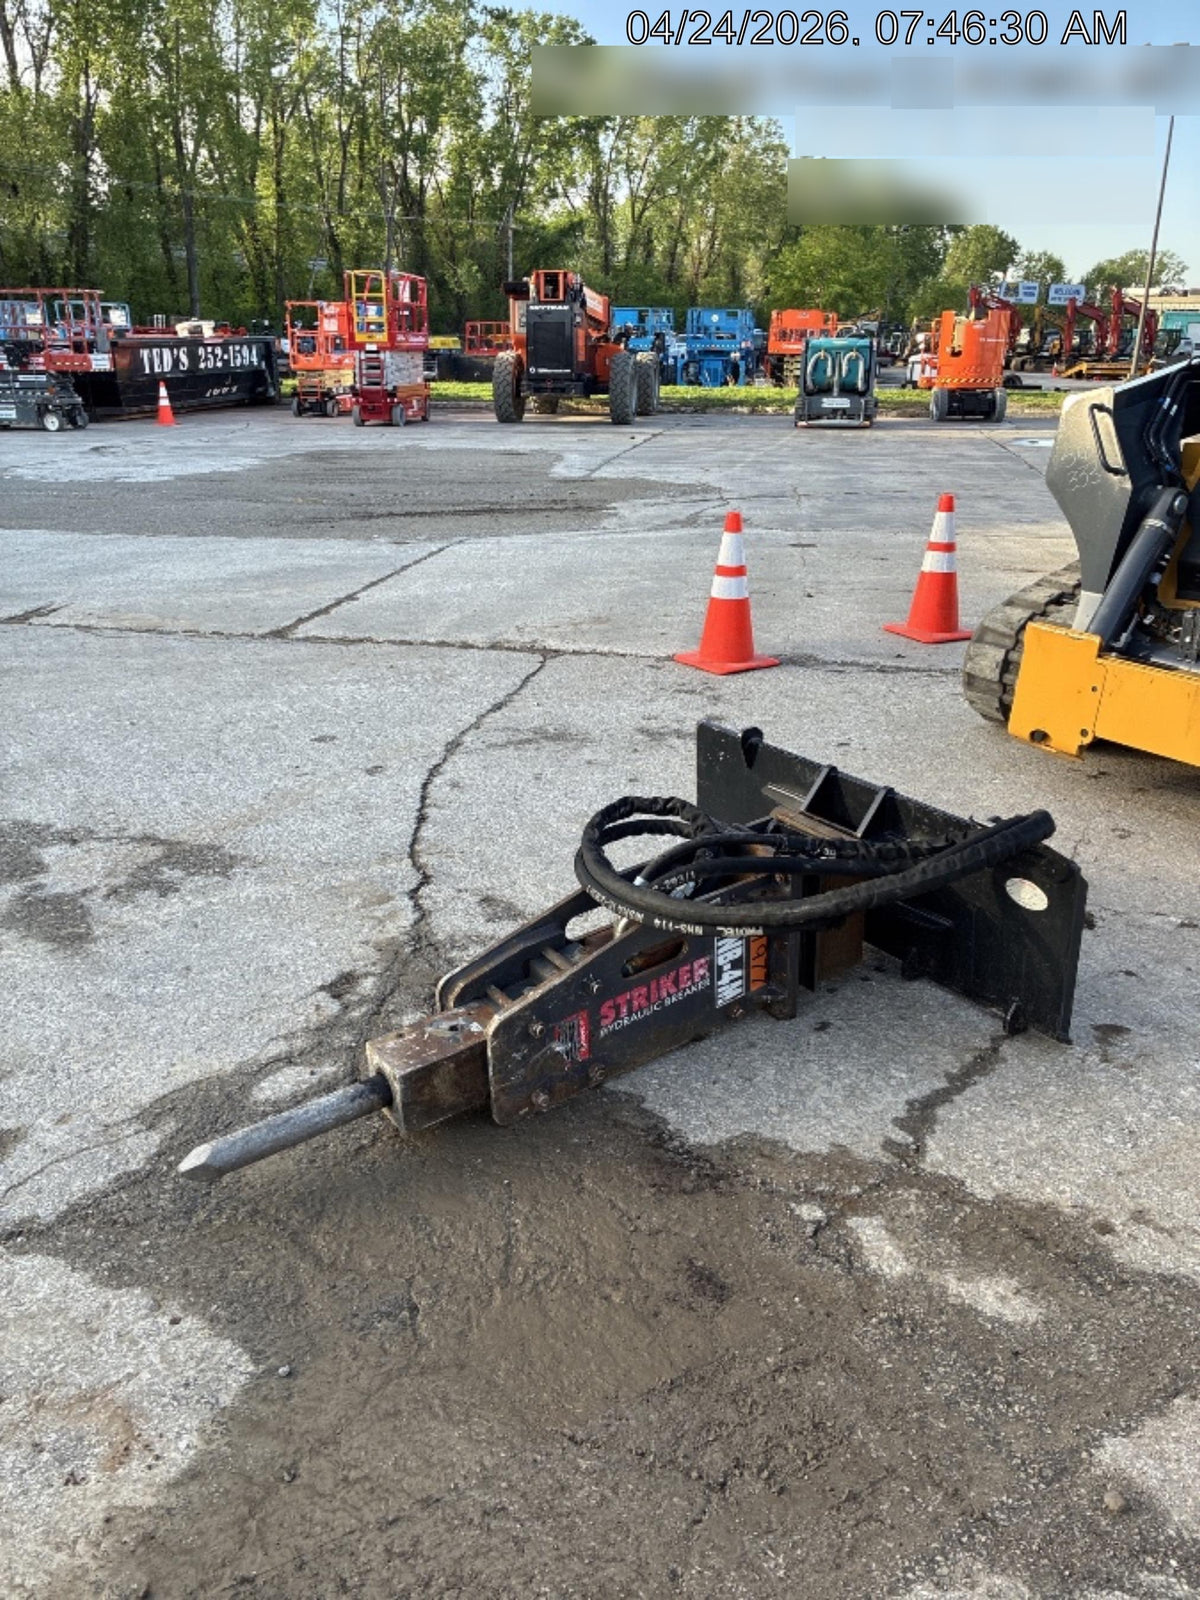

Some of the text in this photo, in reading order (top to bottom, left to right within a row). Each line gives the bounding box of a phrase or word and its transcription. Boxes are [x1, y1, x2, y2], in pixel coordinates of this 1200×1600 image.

[140, 346, 189, 374] TED'S
[198, 344, 258, 369] 252-1594
[599, 956, 712, 1027] STRIKER
